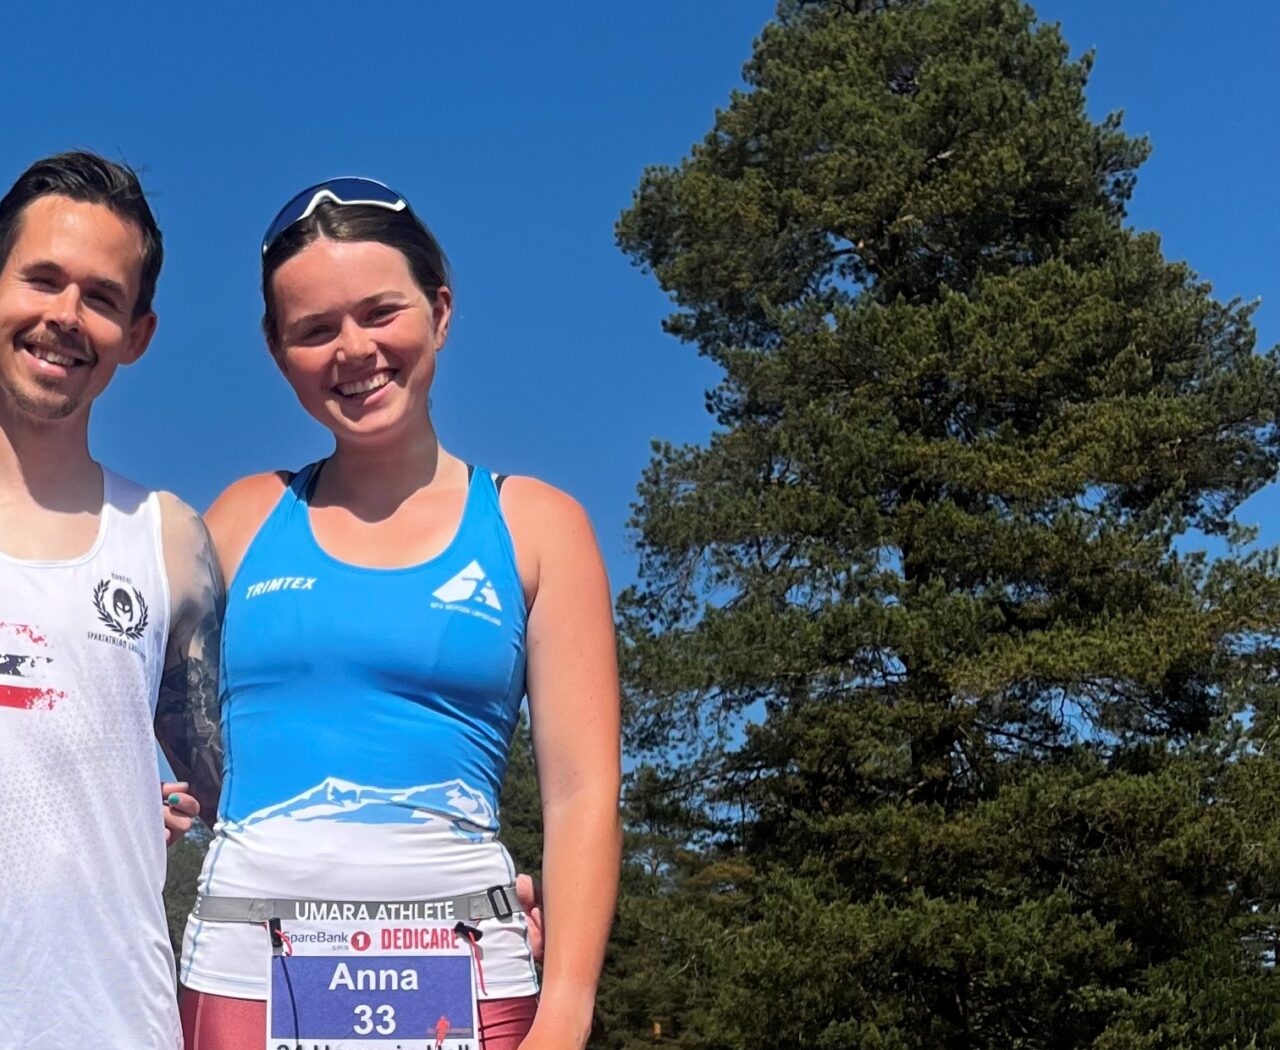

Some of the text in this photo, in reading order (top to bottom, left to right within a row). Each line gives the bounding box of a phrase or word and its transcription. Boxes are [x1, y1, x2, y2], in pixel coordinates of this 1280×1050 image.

[245, 577, 317, 600] TRIMTEX
[294, 900, 455, 920] UMARA ATHLETE
[283, 931, 349, 944] SpareBank
[381, 928, 459, 950] DEDICARE
[328, 962, 419, 991] Anna
[352, 1004, 397, 1036] 33
